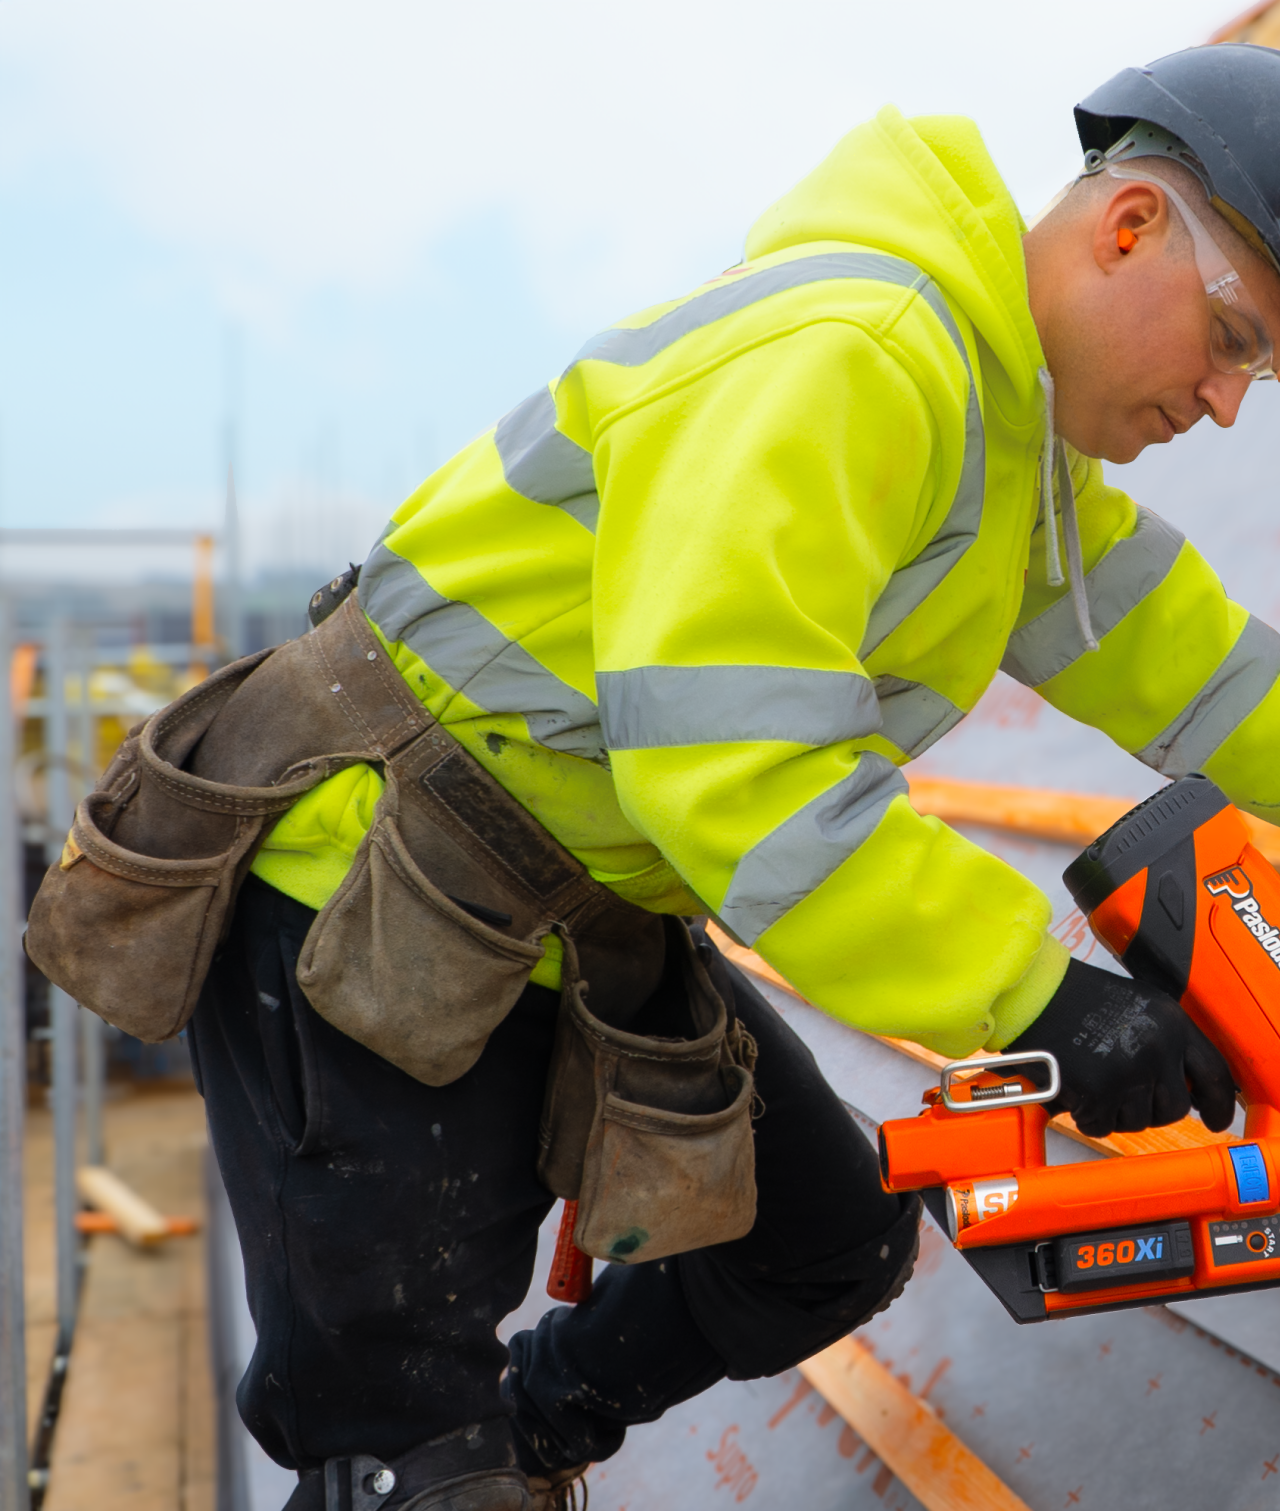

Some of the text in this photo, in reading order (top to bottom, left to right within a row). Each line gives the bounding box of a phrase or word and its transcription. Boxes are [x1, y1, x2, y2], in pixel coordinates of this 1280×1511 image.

[1238, 1154, 1263, 1194] EJECT
[1076, 1236, 1163, 1270] 360Xi
[1263, 1227, 1276, 1259] START
